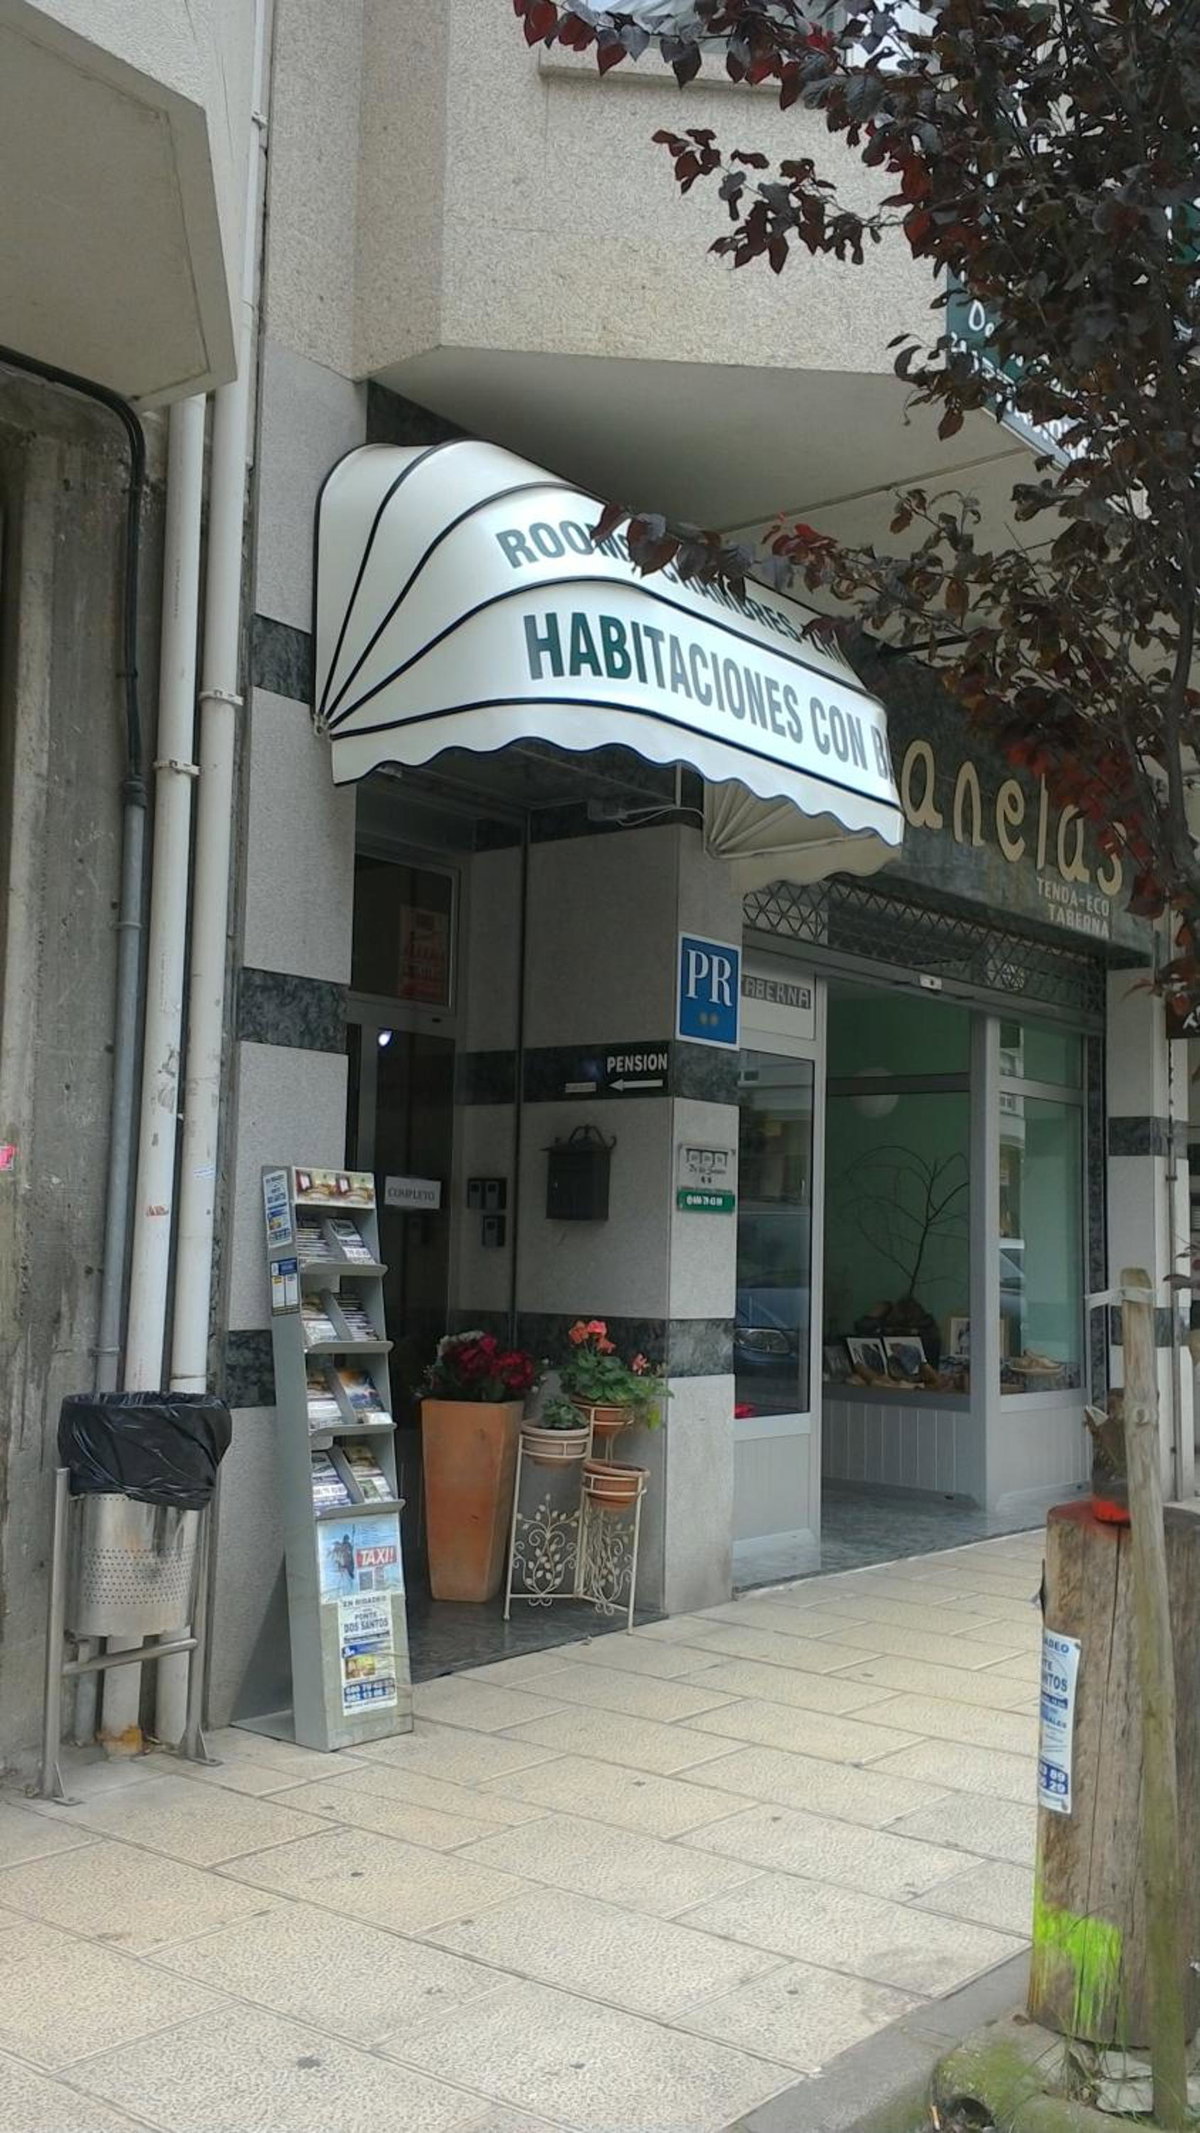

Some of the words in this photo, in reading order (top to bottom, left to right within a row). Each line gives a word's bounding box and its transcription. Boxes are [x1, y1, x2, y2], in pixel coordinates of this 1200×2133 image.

[523, 612, 803, 744] HABITACIONES
[809, 696, 868, 771] CON
[1036, 876, 1110, 917] TENDA-ECO
[1047, 902, 1109, 940] TABERNA
[685, 949, 733, 1007] PR
[742, 976, 810, 1009] ABERNA
[606, 1053, 668, 1073] PENSION
